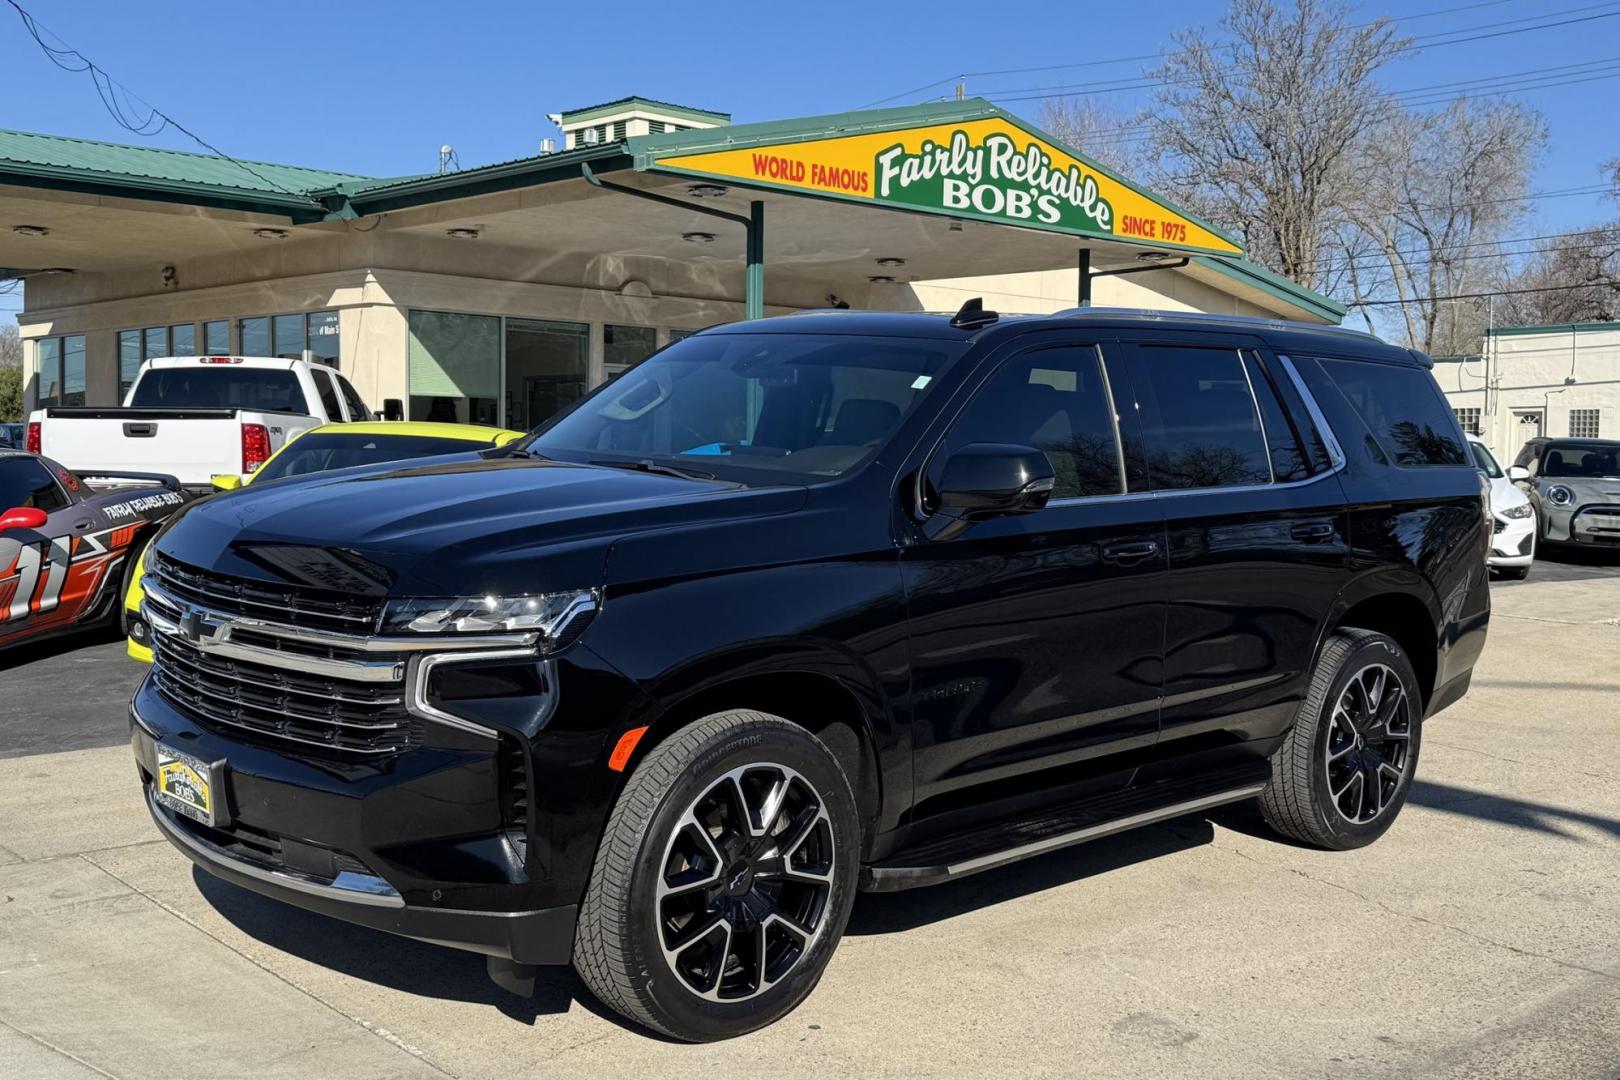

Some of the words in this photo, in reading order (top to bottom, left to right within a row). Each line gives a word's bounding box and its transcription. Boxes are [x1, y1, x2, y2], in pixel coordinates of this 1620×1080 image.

[752, 153, 806, 183] WORLD
[811, 163, 868, 193] FAMOUS
[879, 133, 983, 197] Fairly
[986, 136, 1111, 230] Reliable
[943, 178, 1061, 224] BOB'S
[1122, 215, 1156, 237] SINCE
[1160, 221, 1186, 242] 1975
